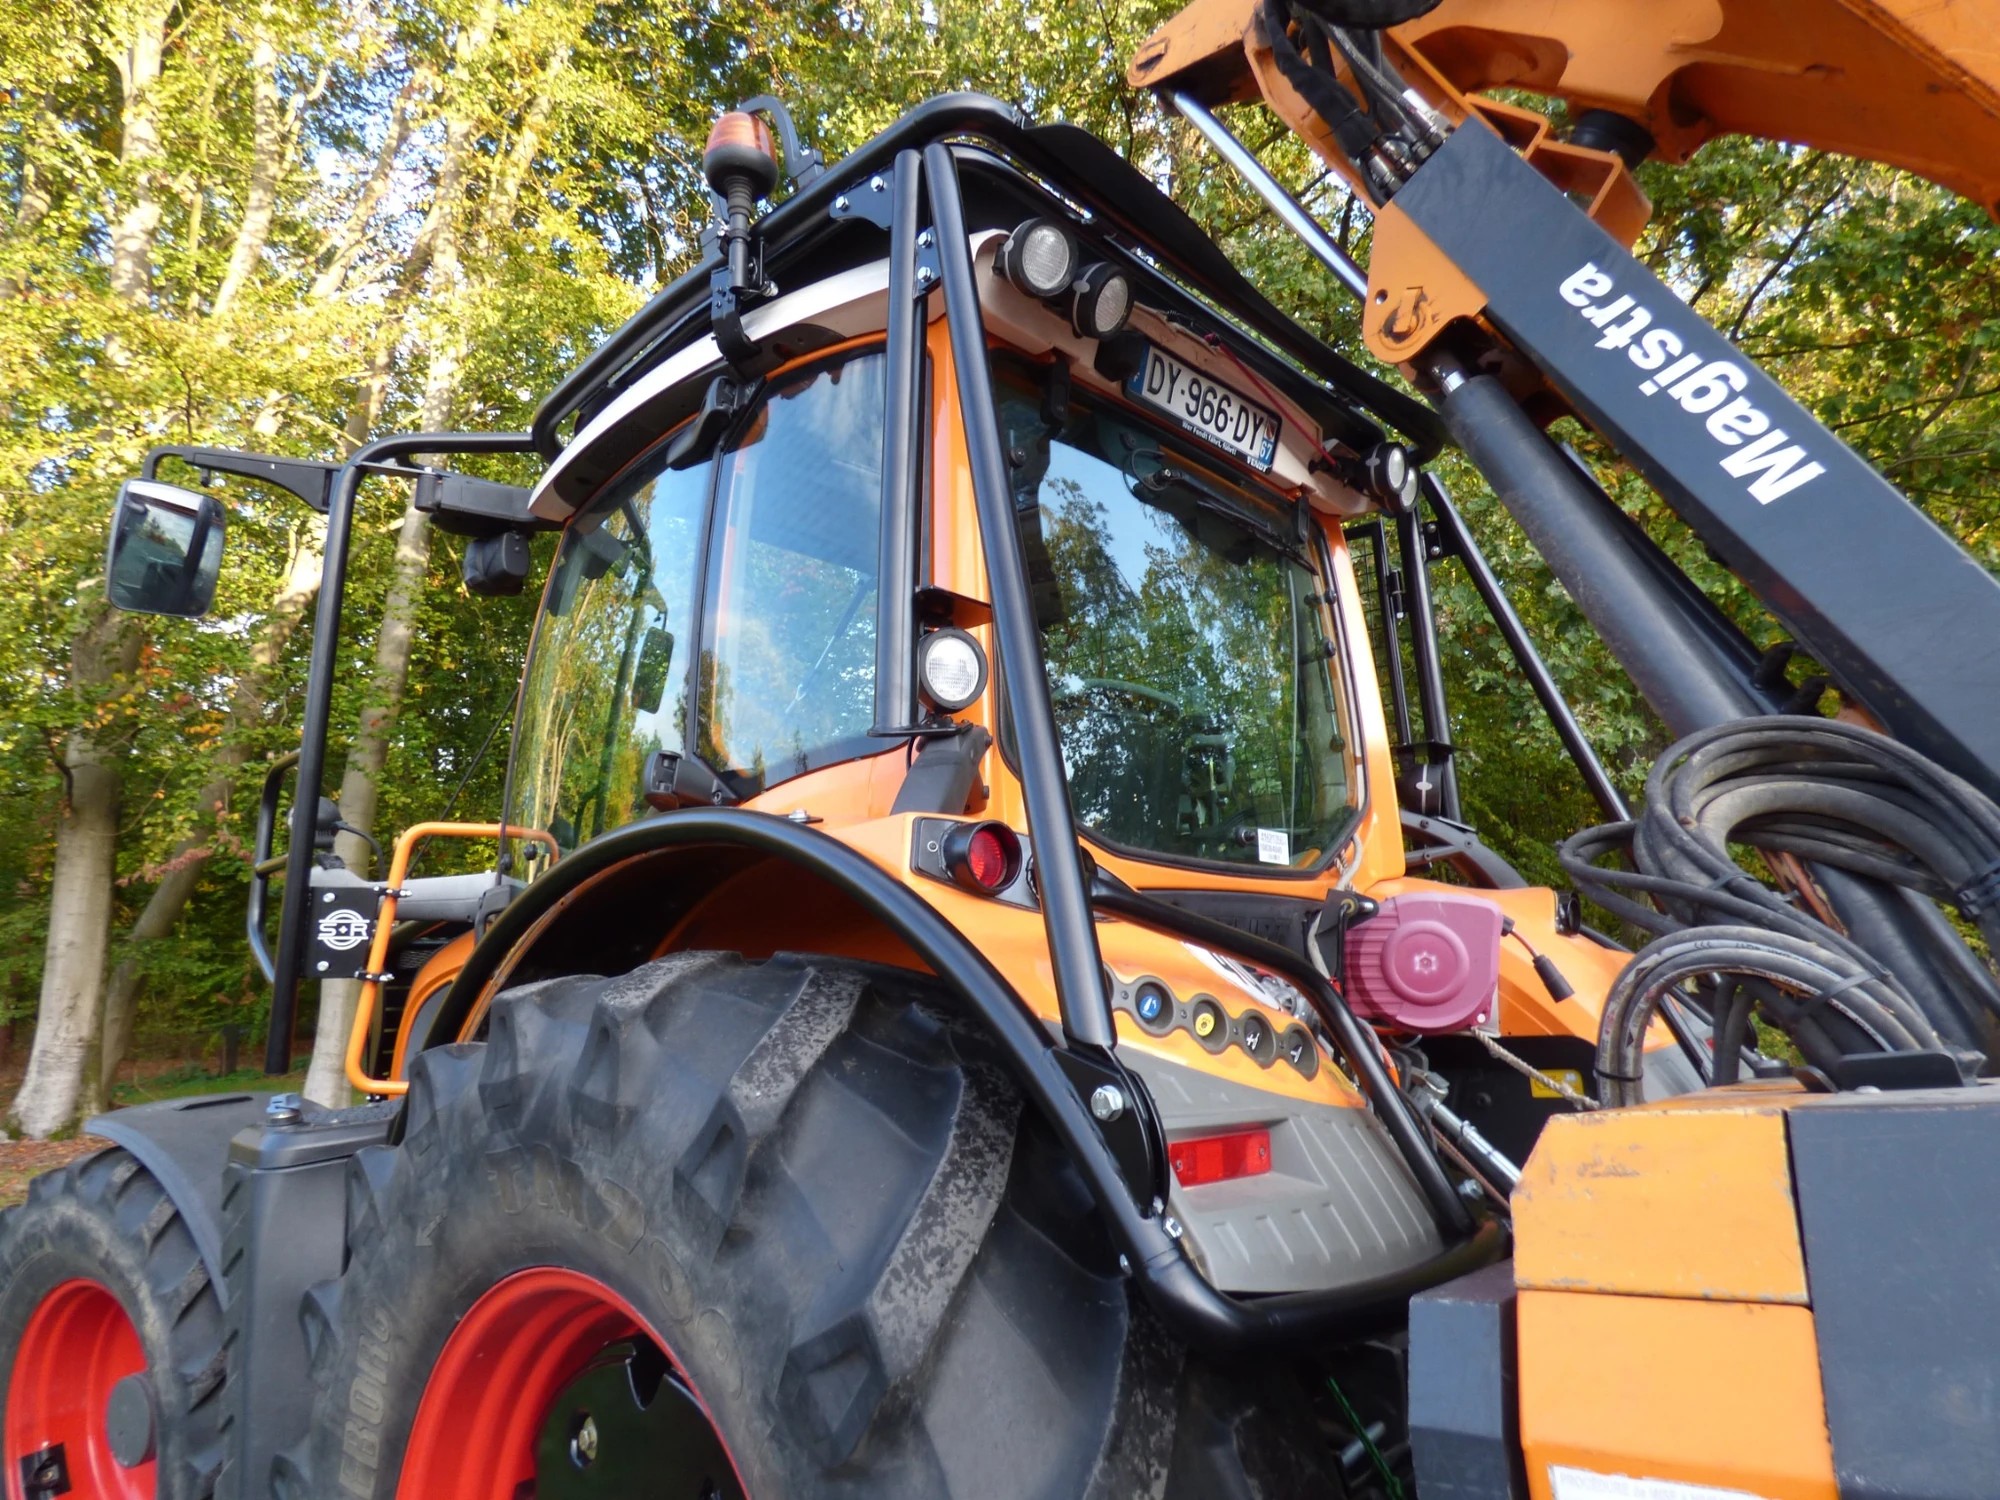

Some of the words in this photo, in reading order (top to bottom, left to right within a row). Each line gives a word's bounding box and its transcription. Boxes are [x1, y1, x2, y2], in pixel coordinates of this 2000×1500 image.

[1147, 352, 1264, 451] DY-966-DY
[1260, 440, 1273, 461] 67
[1193, 427, 1208, 440] Fendt
[1559, 262, 1826, 505] Magistra
